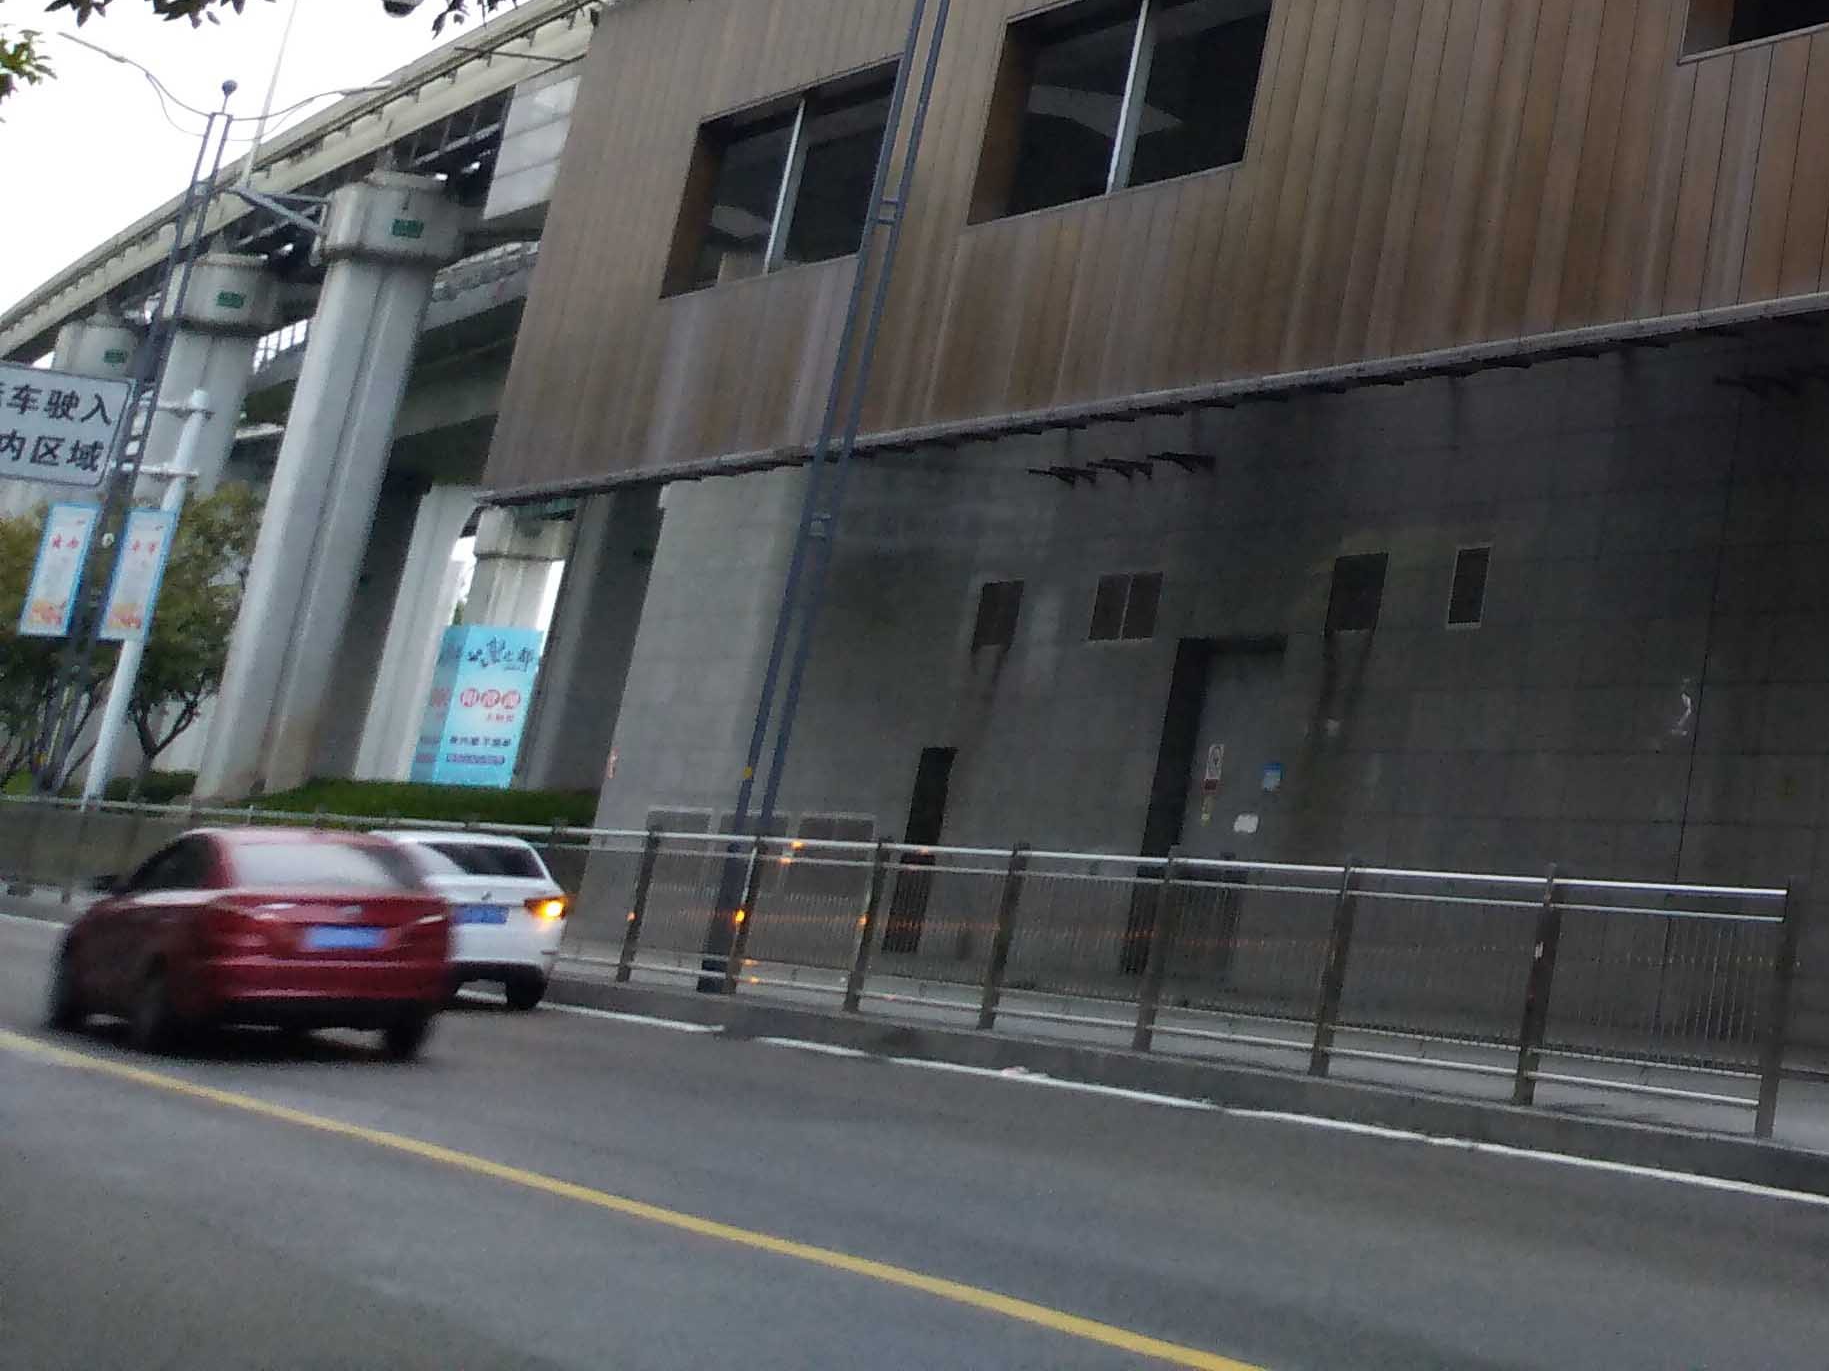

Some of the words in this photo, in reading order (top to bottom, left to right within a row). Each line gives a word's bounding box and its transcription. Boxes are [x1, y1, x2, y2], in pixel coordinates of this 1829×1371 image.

[0, 381, 112, 426] 车驶入
[0, 427, 105, 473] 内区域
